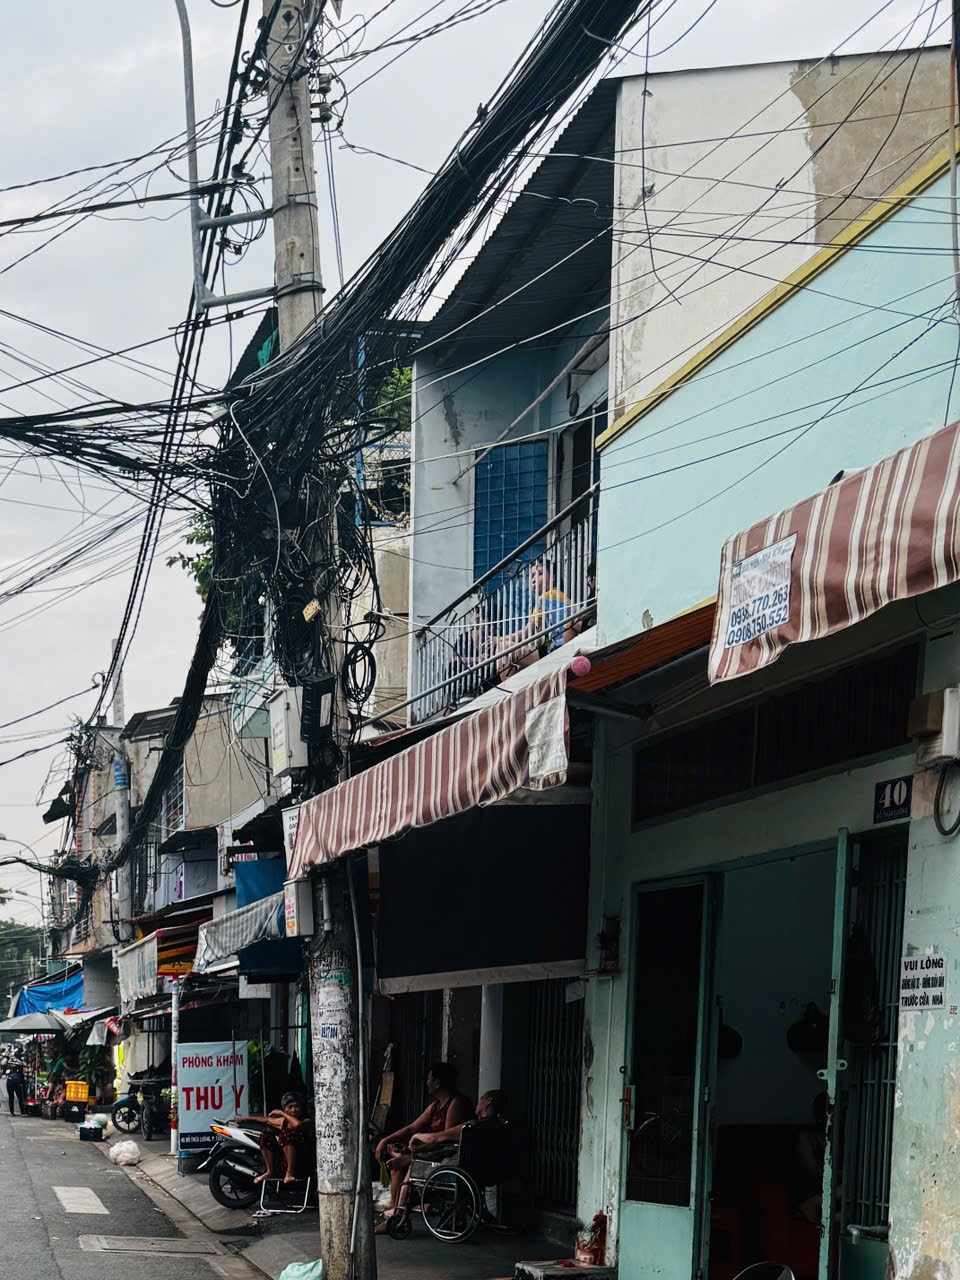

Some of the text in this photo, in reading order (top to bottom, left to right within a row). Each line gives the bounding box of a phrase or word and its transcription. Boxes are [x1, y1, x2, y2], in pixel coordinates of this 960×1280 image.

[879, 780, 907, 808] 40
[904, 956, 944, 971] VUI LÒNG
[901, 991, 943, 1007] TRƯỚC CỬA NHÀ
[182, 1053, 213, 1068] PHÒNG
[182, 1078, 245, 1111] THÚ Y
